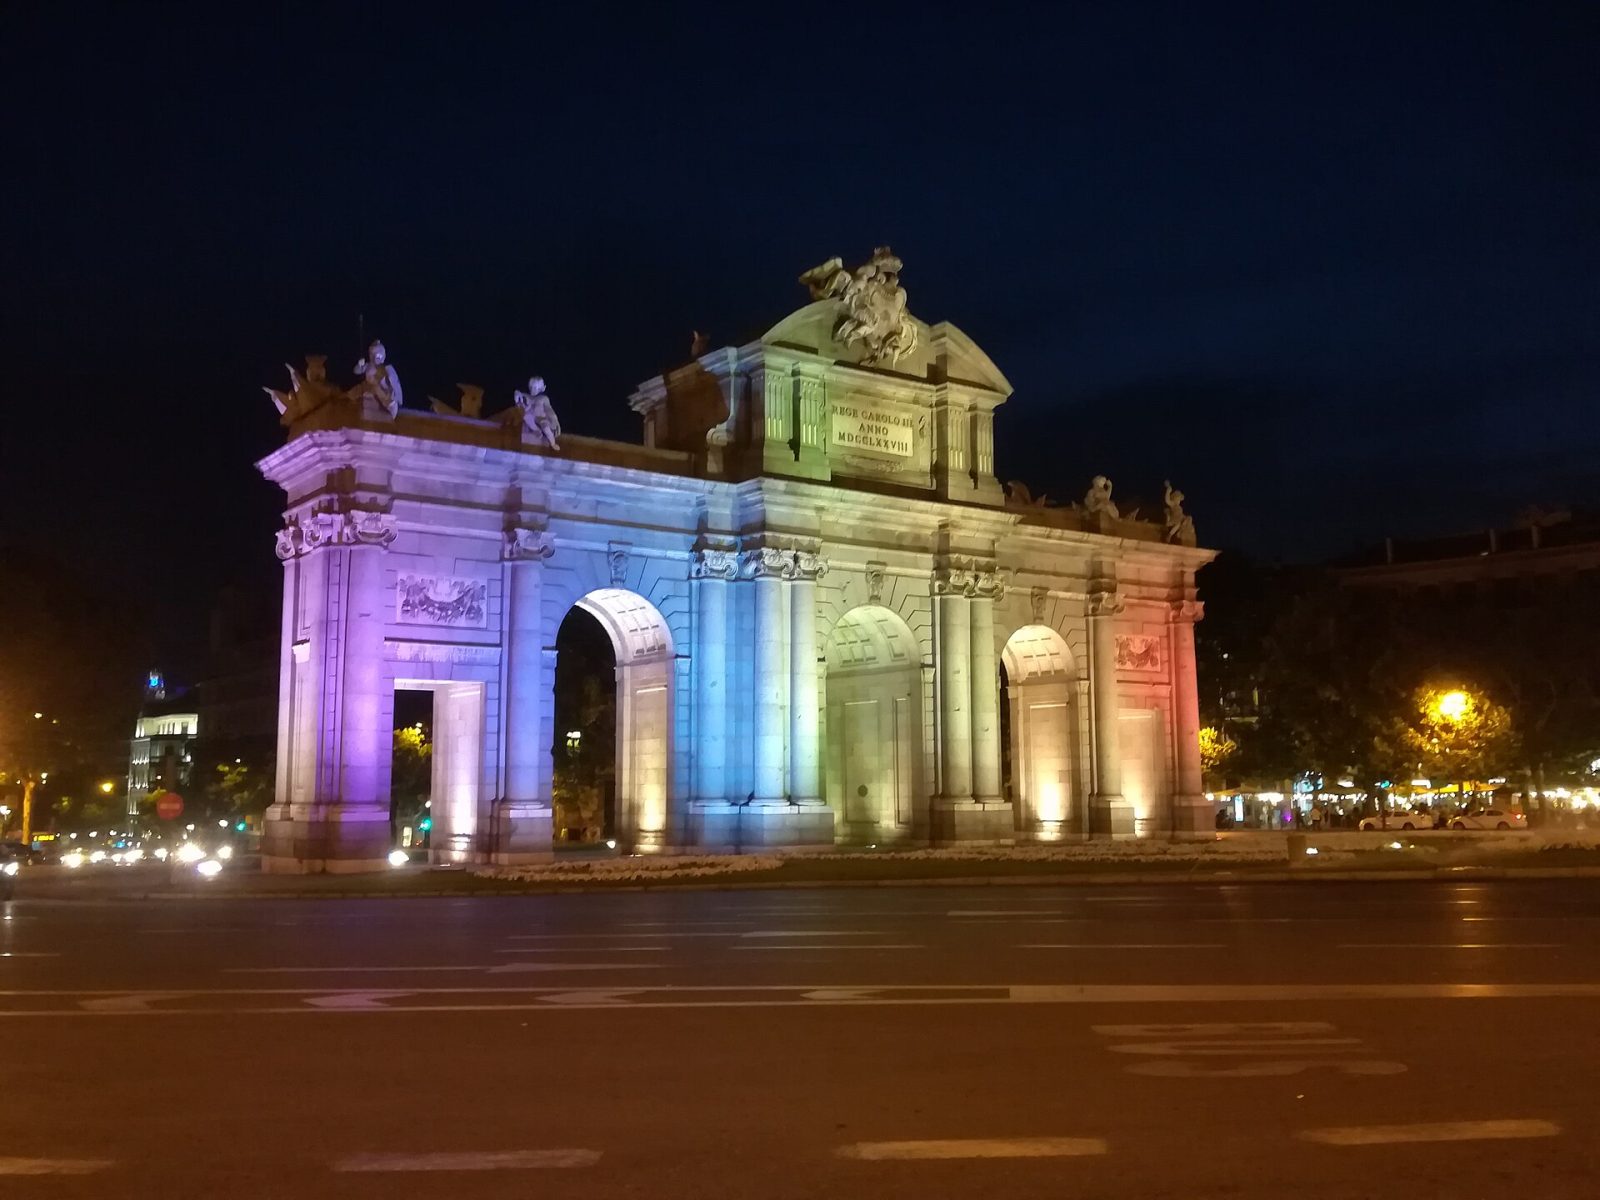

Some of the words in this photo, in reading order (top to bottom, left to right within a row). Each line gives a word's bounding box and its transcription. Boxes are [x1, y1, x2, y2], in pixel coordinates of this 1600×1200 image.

[832, 405, 858, 418] REGE
[861, 410, 900, 426] CAROLO
[859, 422, 889, 436] ANNO
[838, 431, 908, 453] MDCCLXXVIII
[1090, 1022, 1408, 1077] BUS
